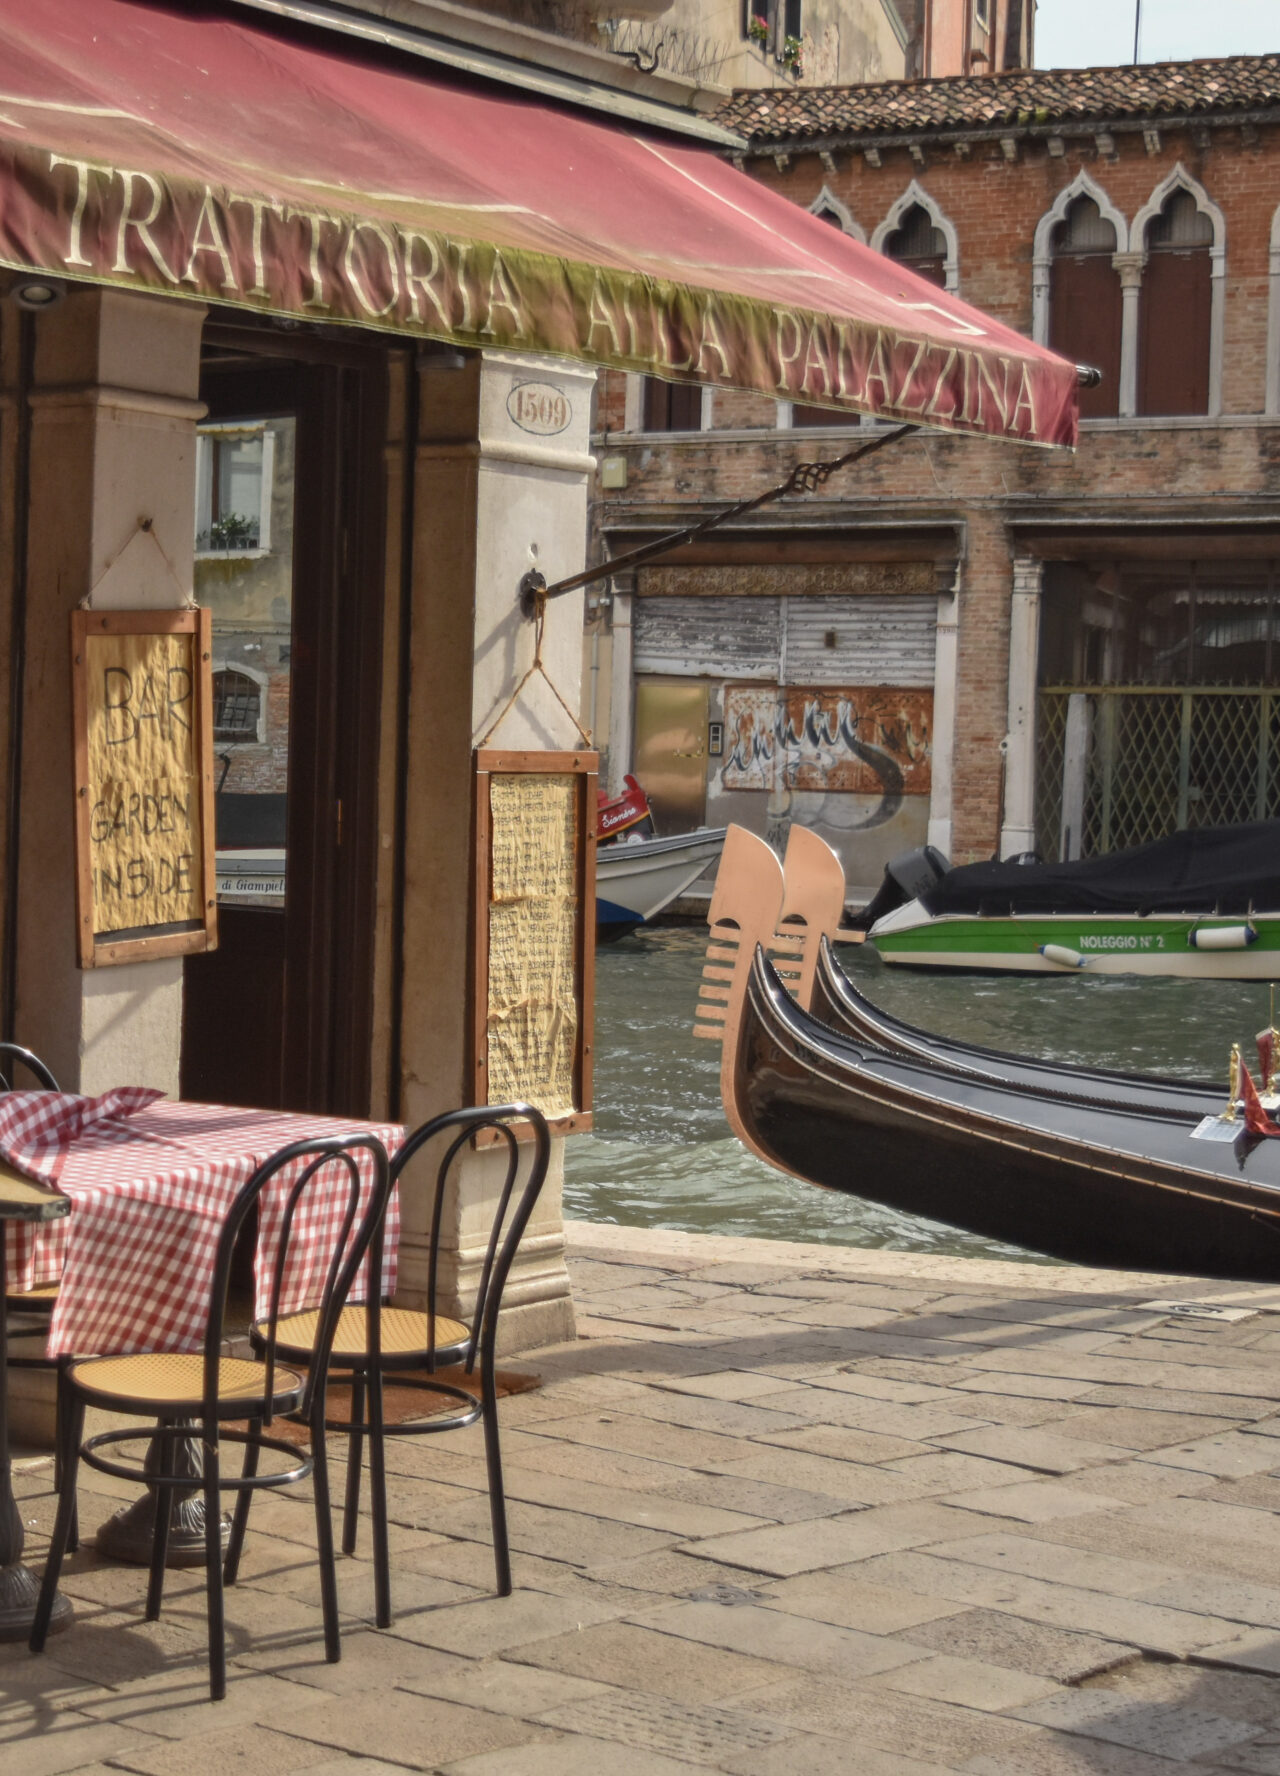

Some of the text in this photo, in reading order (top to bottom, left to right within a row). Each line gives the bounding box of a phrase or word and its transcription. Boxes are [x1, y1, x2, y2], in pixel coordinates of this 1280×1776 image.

[50, 154, 1038, 434] TRATTORIA ALLA PALAZZINA
[516, 391, 567, 427] 1509
[104, 667, 193, 745] BAR
[90, 793, 190, 843] GARDEN
[94, 855, 194, 906] INSIDE
[221, 879, 232, 890] di
[1080, 935, 1137, 949] NOLEGGIO
[1156, 935, 1165, 948] 2
